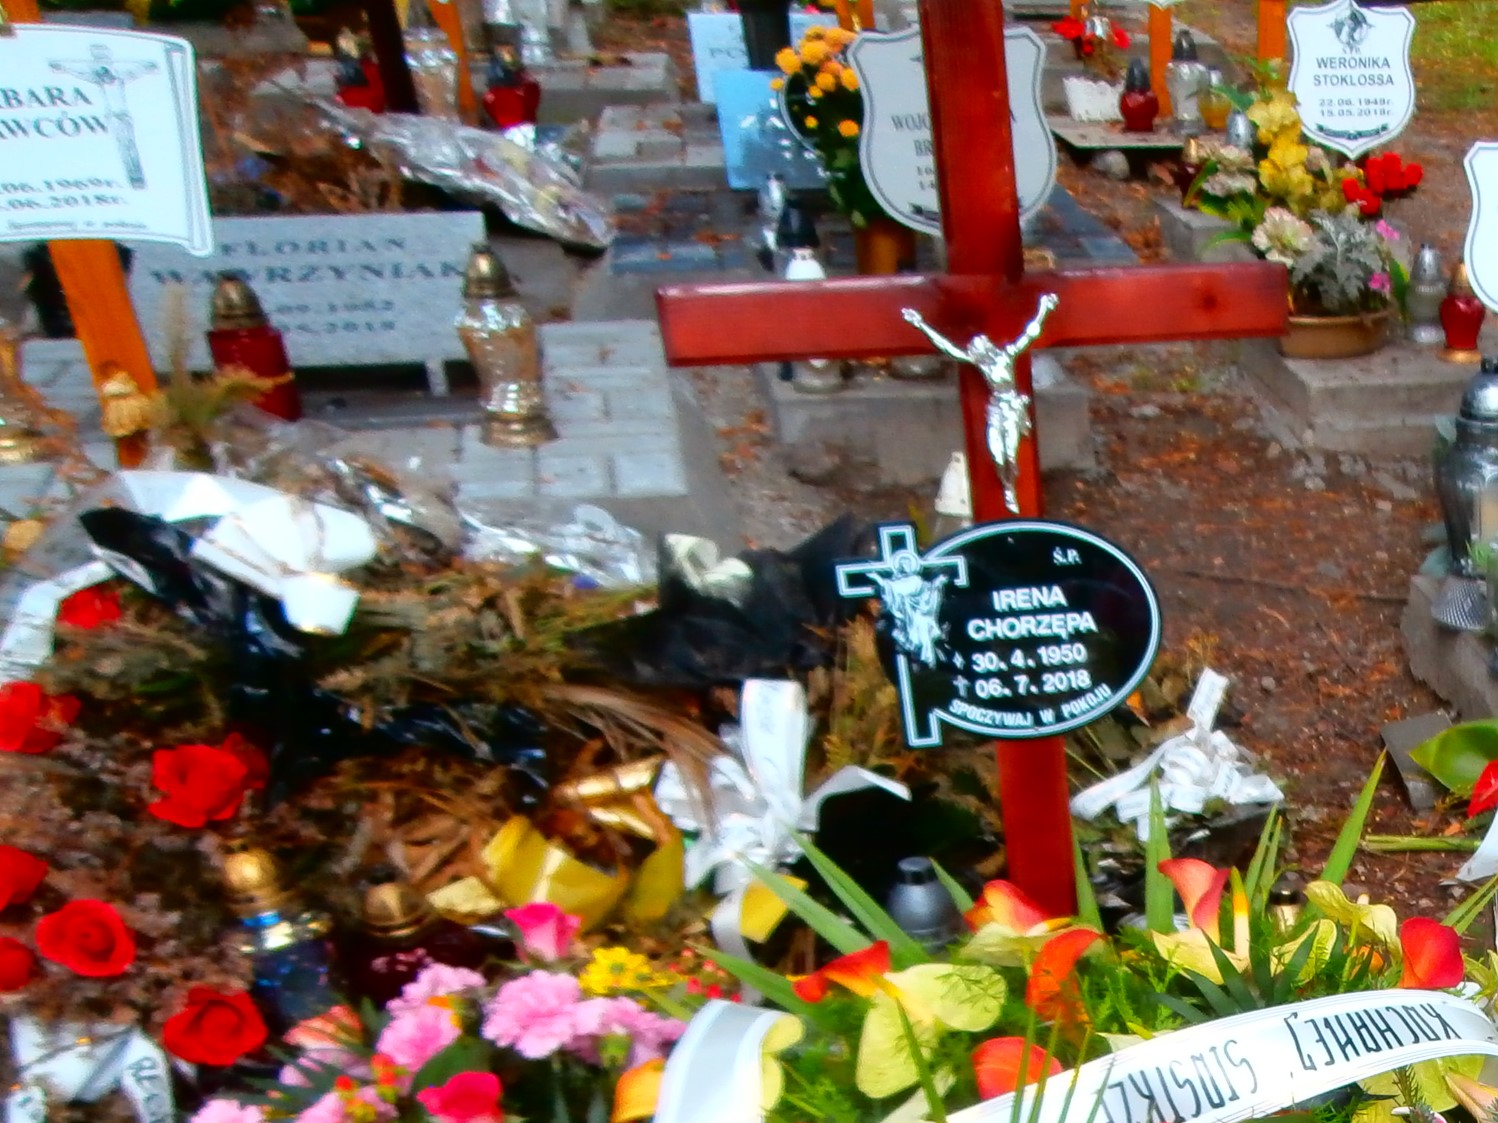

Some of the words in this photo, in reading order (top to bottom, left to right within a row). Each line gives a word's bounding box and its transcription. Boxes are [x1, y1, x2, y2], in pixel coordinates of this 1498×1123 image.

[1316, 57, 1391, 69] WERONIKA
[1313, 74, 1395, 87] STOKLOSSA
[992, 585, 1068, 612] IRENA
[967, 611, 1098, 641] CHORZĘPA
[1037, 643, 1088, 666] 1950
[1043, 669, 1092, 692] 2018
[950, 699, 1034, 727] SPOCZYWAJ
